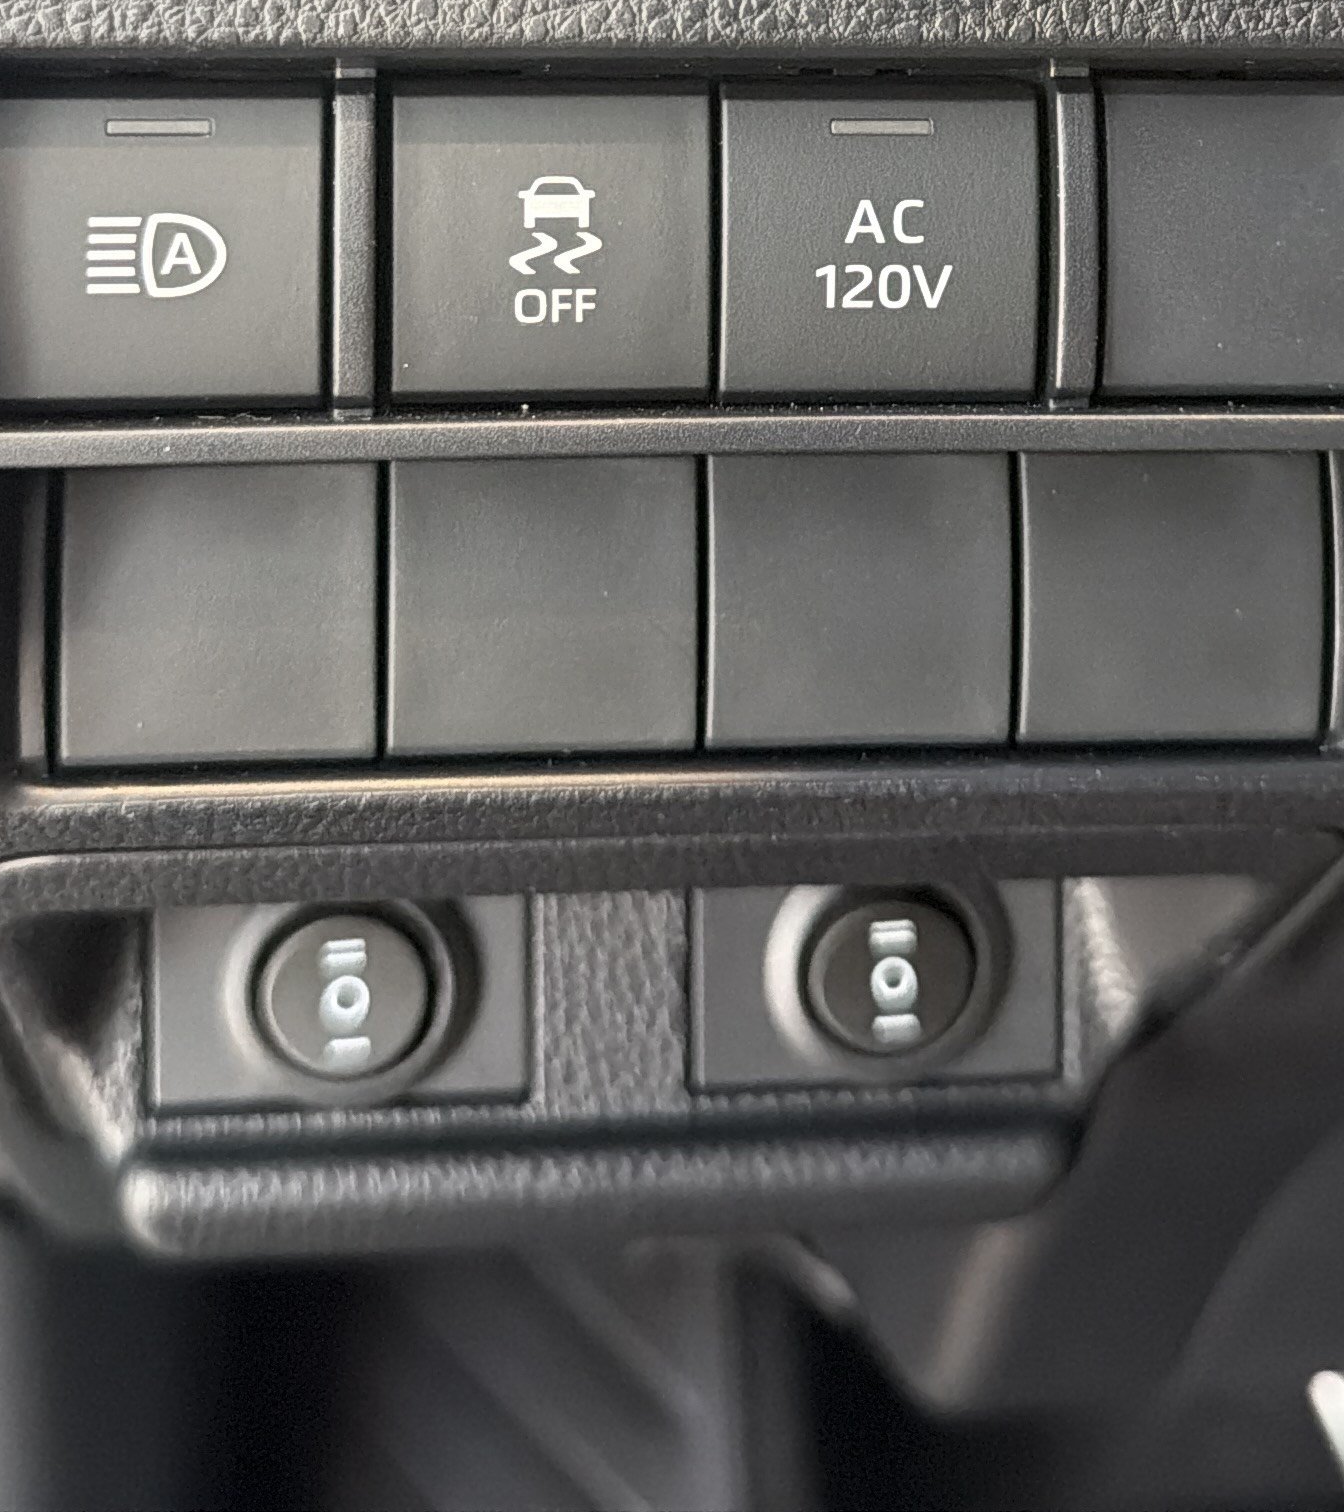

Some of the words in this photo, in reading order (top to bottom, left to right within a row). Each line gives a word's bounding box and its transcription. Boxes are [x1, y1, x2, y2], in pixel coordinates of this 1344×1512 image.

[844, 199, 925, 244] AC
[514, 288, 597, 324] OFF
[815, 264, 954, 309] 120V
